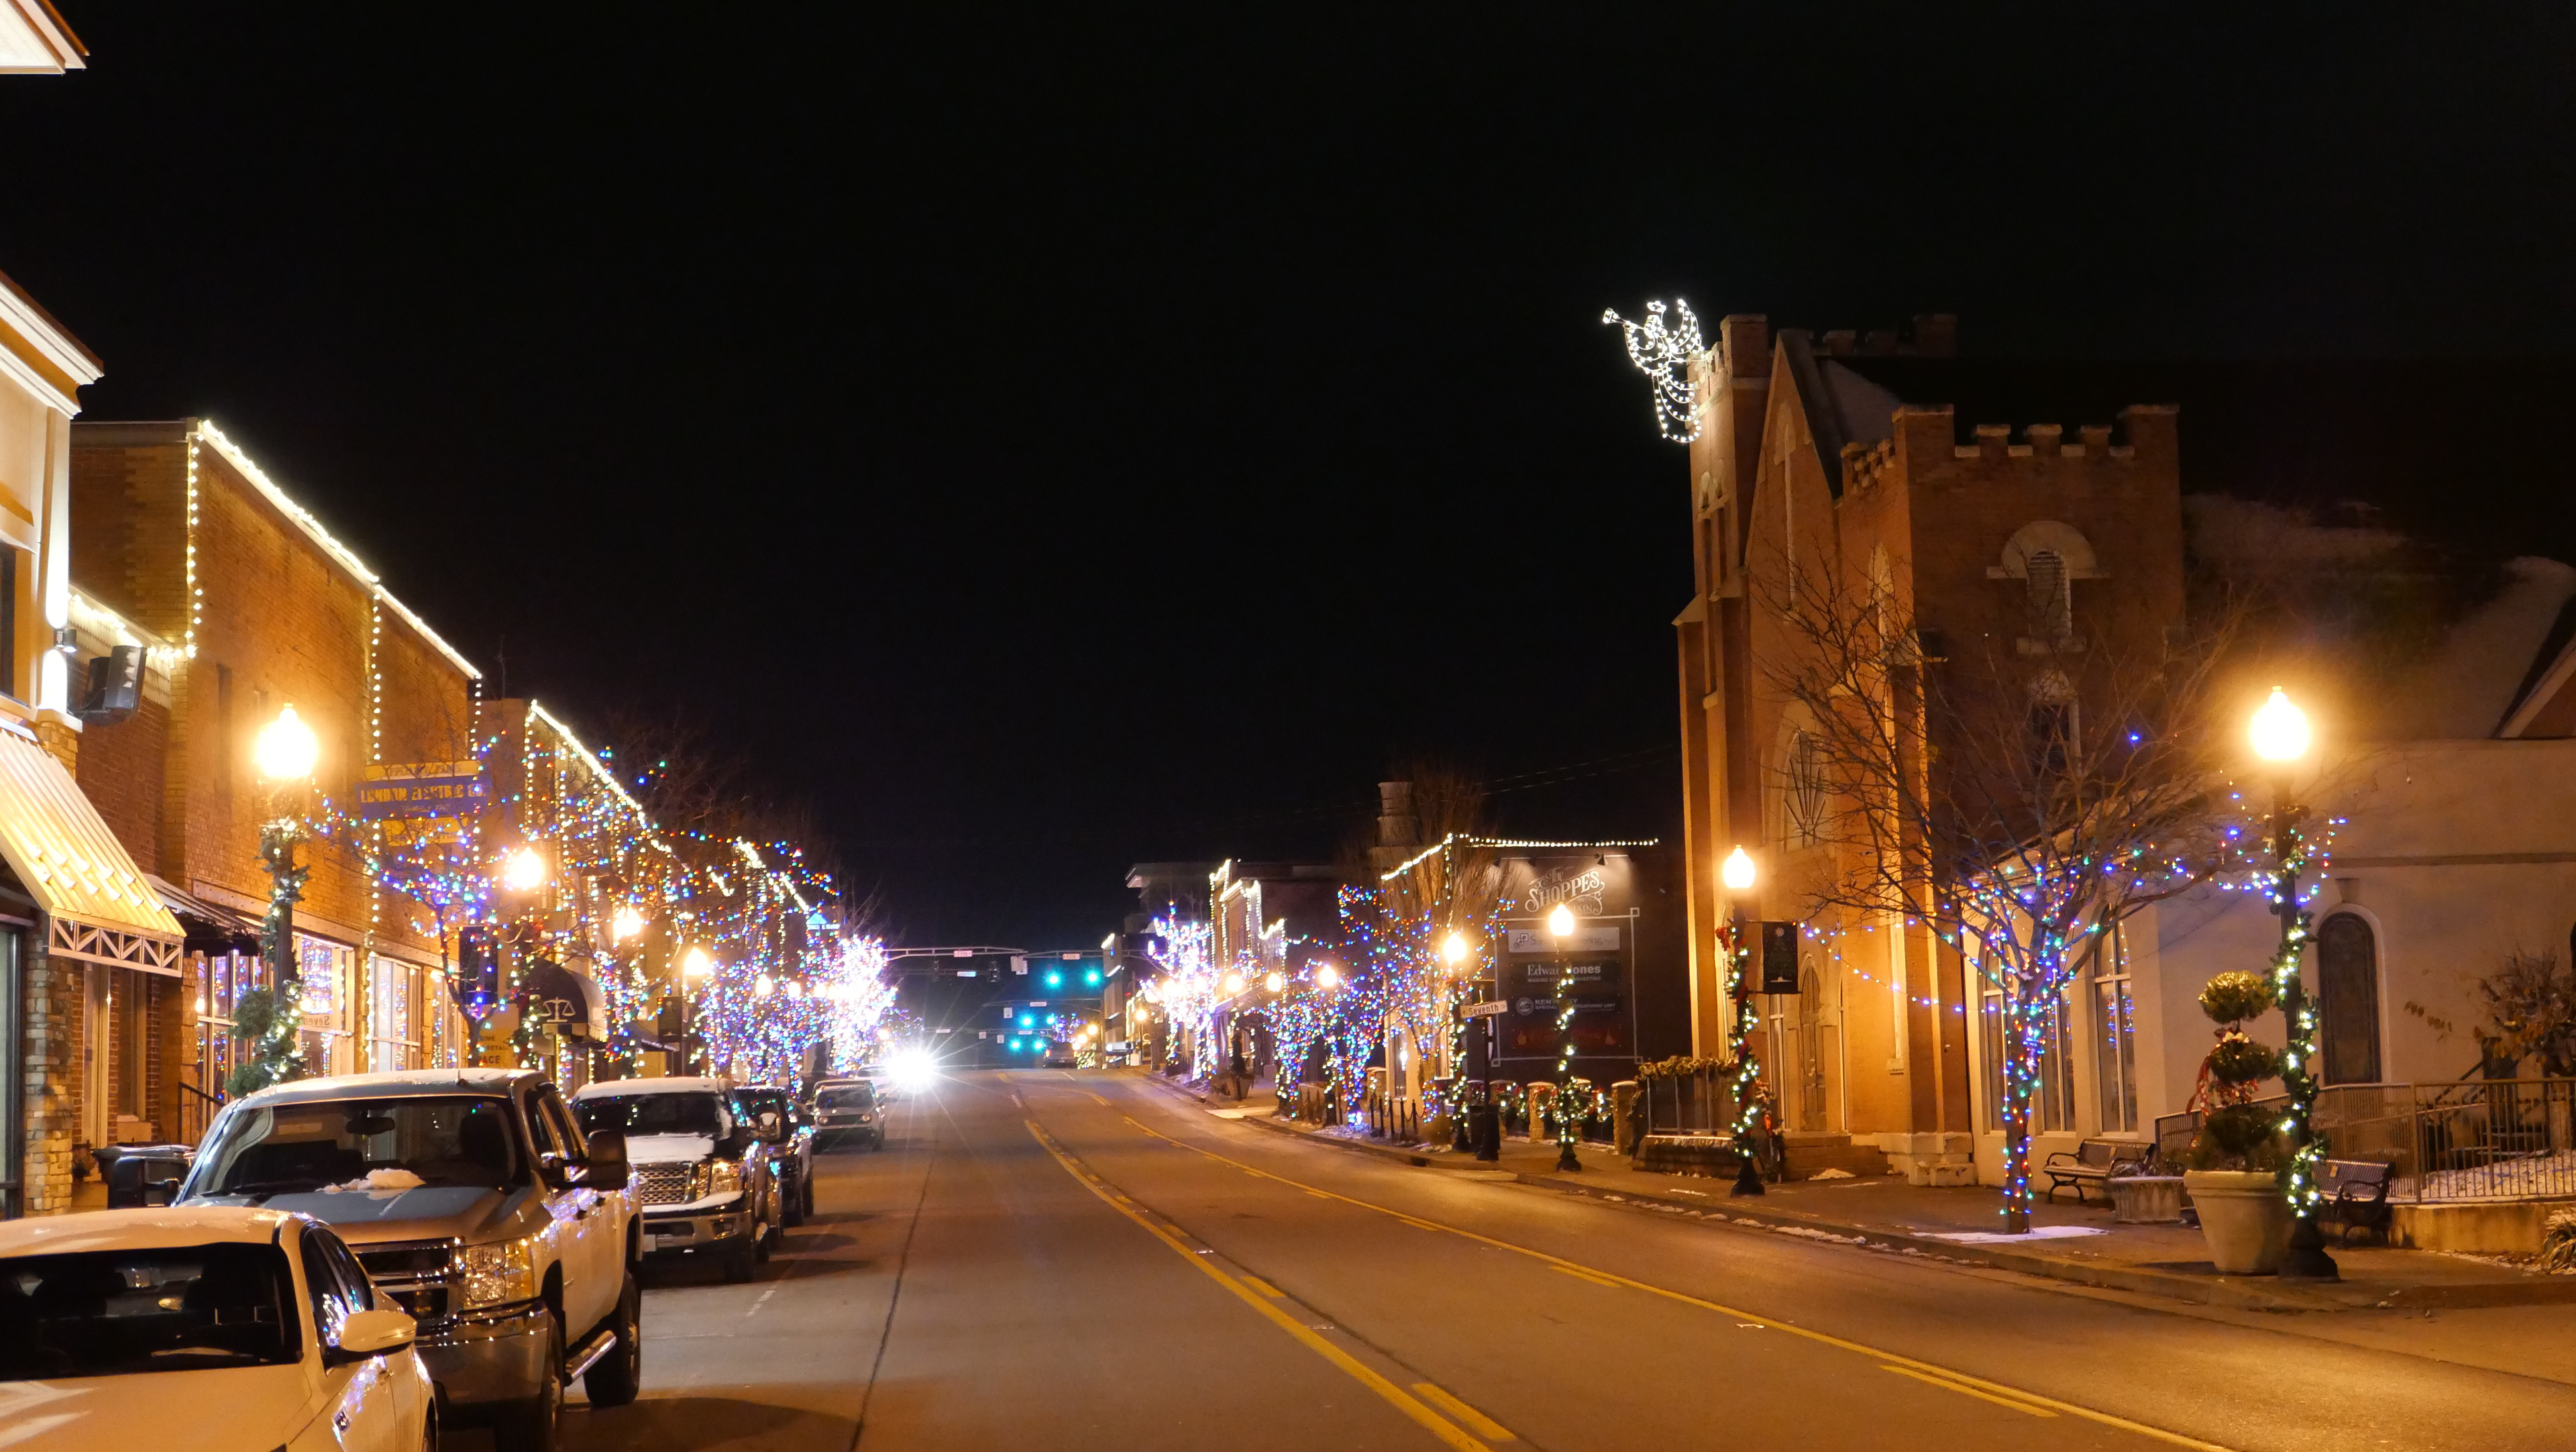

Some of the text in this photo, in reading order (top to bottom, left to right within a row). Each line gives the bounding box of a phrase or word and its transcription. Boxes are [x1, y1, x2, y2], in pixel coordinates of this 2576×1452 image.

[1524, 870, 1605, 913] SHOPPES
[1527, 964, 1559, 976] Edwar
[1468, 1003, 1499, 1016] Seventh
